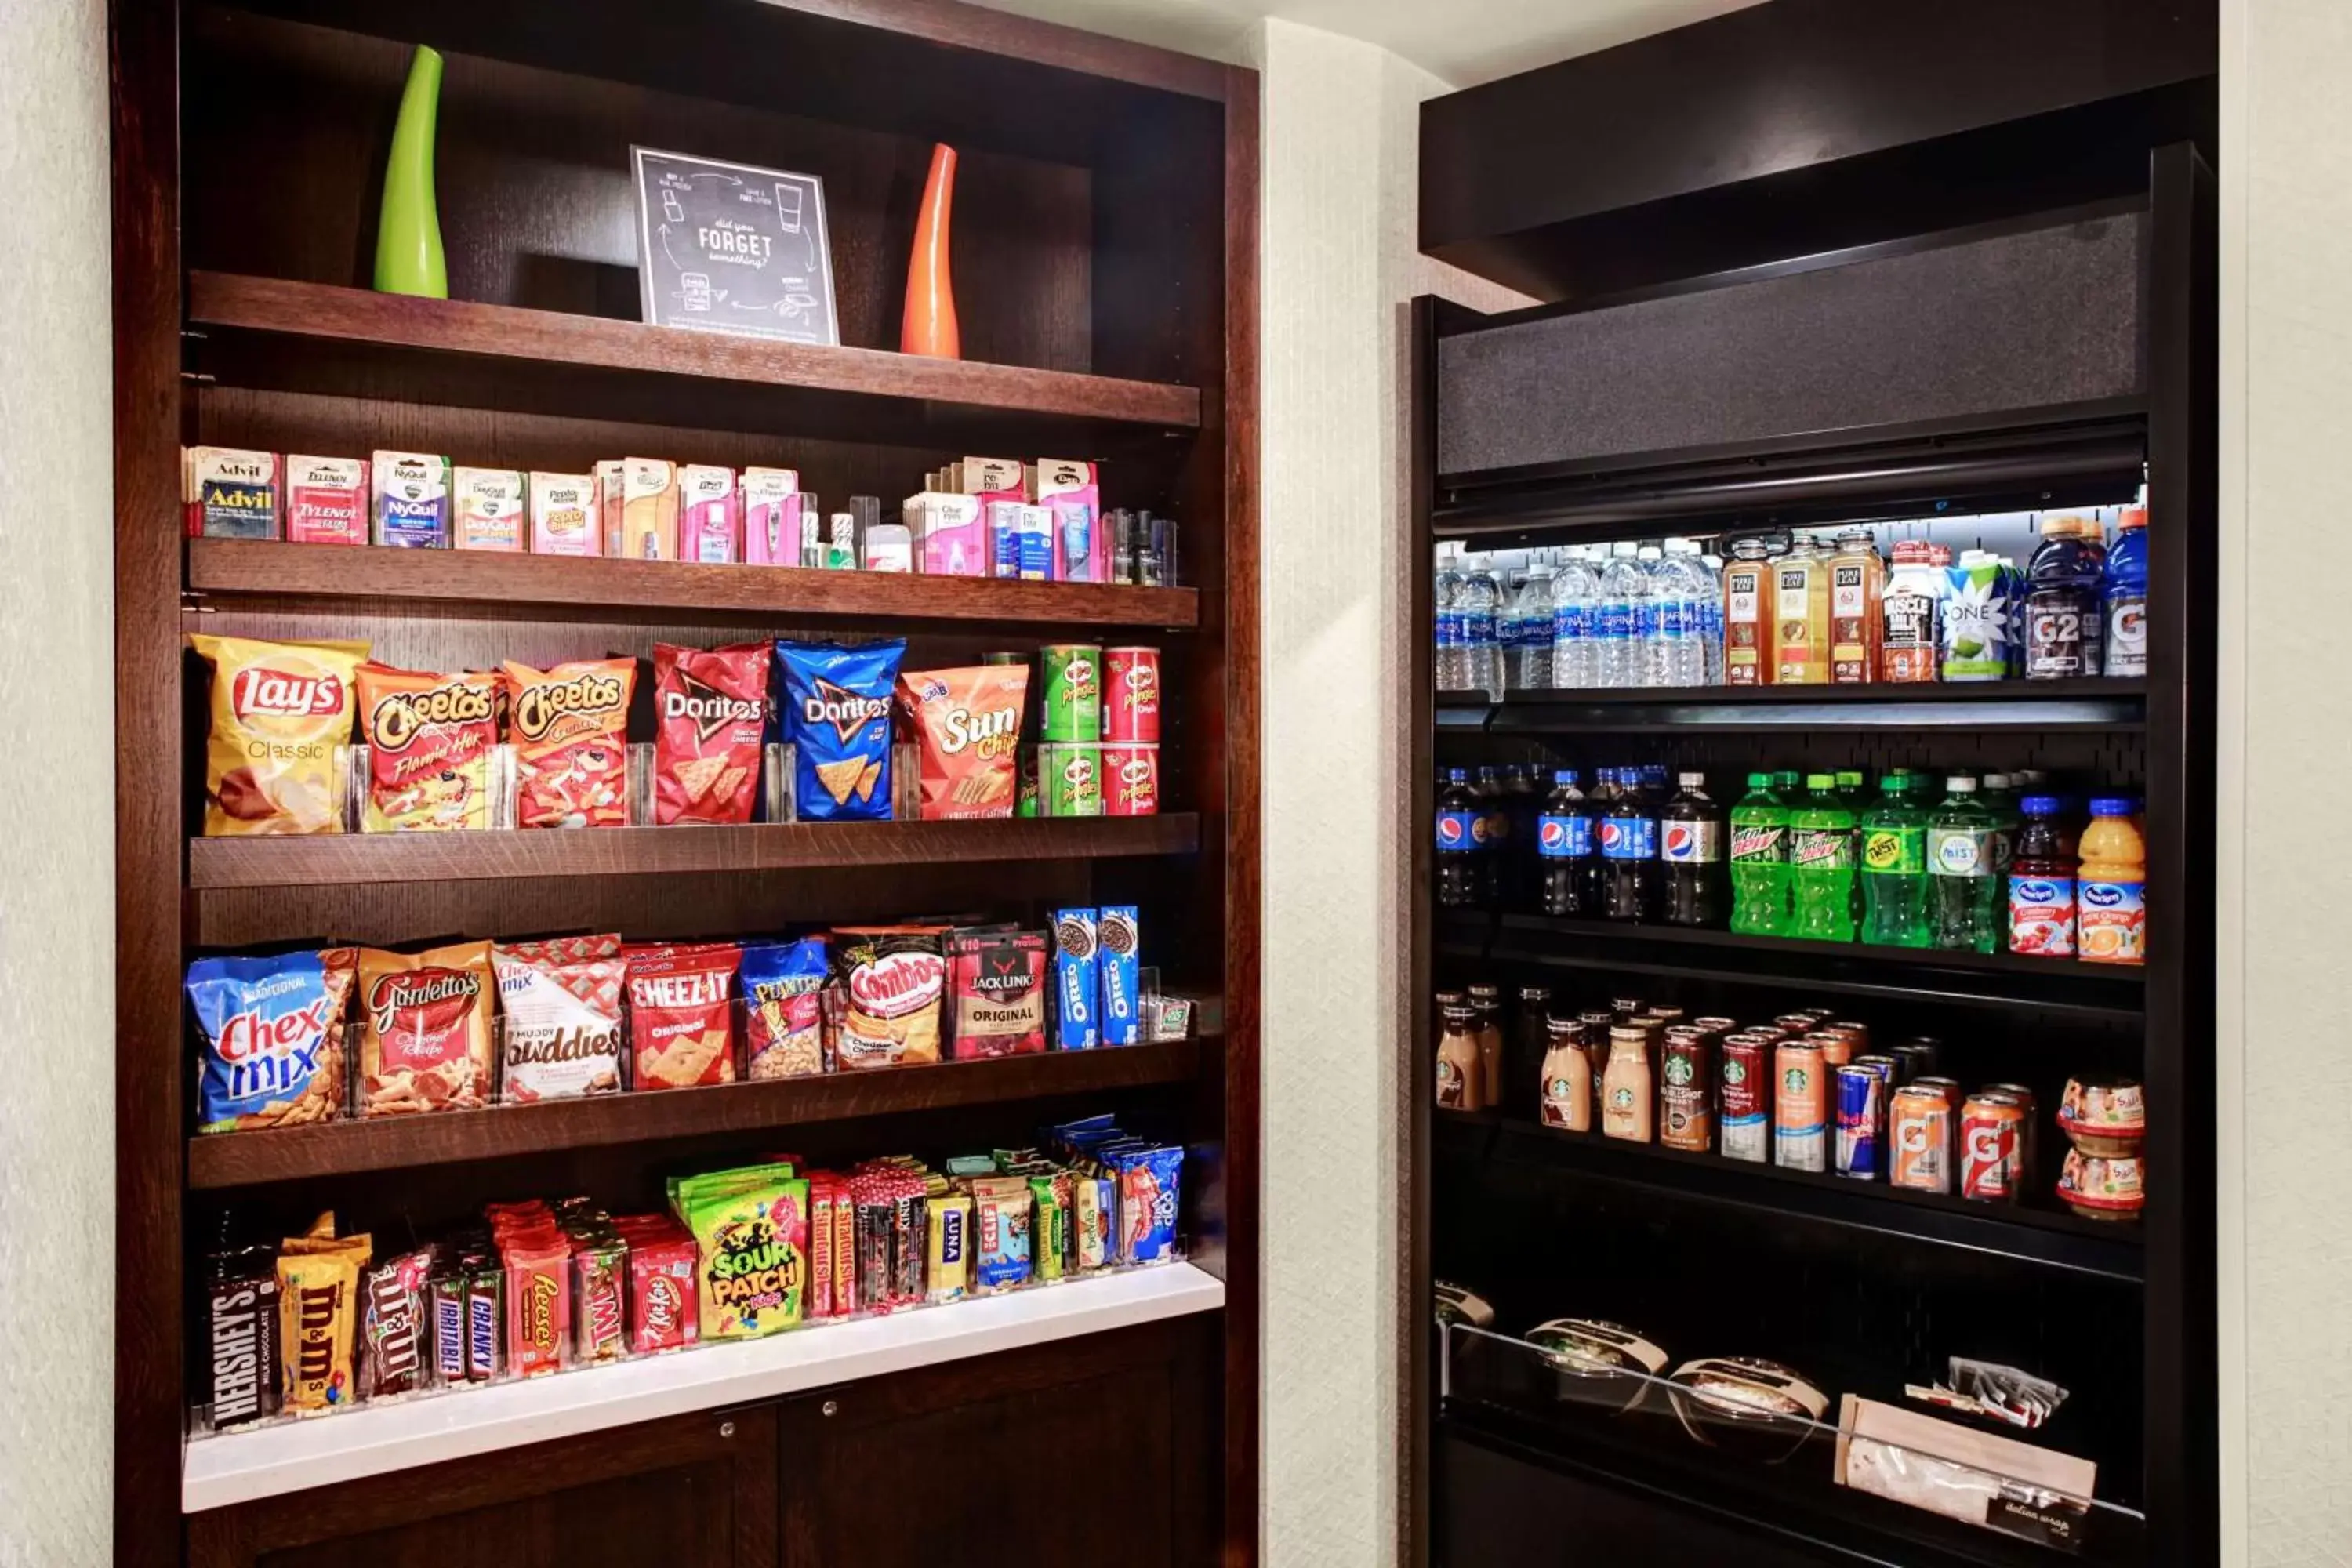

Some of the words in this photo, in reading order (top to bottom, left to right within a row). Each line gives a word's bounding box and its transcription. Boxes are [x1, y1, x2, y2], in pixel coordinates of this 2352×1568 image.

[699, 227, 772, 257] FORGET
[216, 463, 260, 477] Advil
[208, 488, 272, 509] Advil
[388, 500, 439, 517] NyQuil
[2033, 613, 2079, 644] G2
[2111, 603, 2147, 643] G
[240, 670, 337, 717] Lay's
[517, 676, 622, 740] Cheetos
[666, 692, 761, 720] Doritos
[806, 696, 893, 723] Doritos
[373, 682, 492, 751] Cheetos
[942, 707, 1016, 753] Sun
[248, 741, 324, 760] Classic
[503, 973, 533, 992] mix
[852, 957, 945, 1001] Combos
[971, 977, 1003, 990] JACK
[1067, 963, 1088, 1022] OREO
[1109, 958, 1129, 1018] OREO
[369, 971, 481, 1035] Gardetto's
[973, 1007, 1034, 1022] ORIGINAL
[220, 999, 325, 1061] Chex
[508, 1025, 619, 1066] buddies
[233, 1035, 322, 1097] mix
[1897, 1118, 1926, 1152] G
[1968, 1127, 1999, 1162] G
[901, 1198, 910, 1231] KIND
[984, 1207, 997, 1242] CLIF
[947, 1214, 959, 1258] LUNA
[714, 1241, 793, 1279] SOUR
[713, 1261, 797, 1305] PATCH
[533, 1272, 559, 1349] Reese's
[260, 1310, 270, 1368] CHOCOLATE
[440, 1301, 460, 1373] IRRITABLE
[471, 1299, 492, 1368] CRANKY
[212, 1289, 258, 1421] HERSHEY'S
